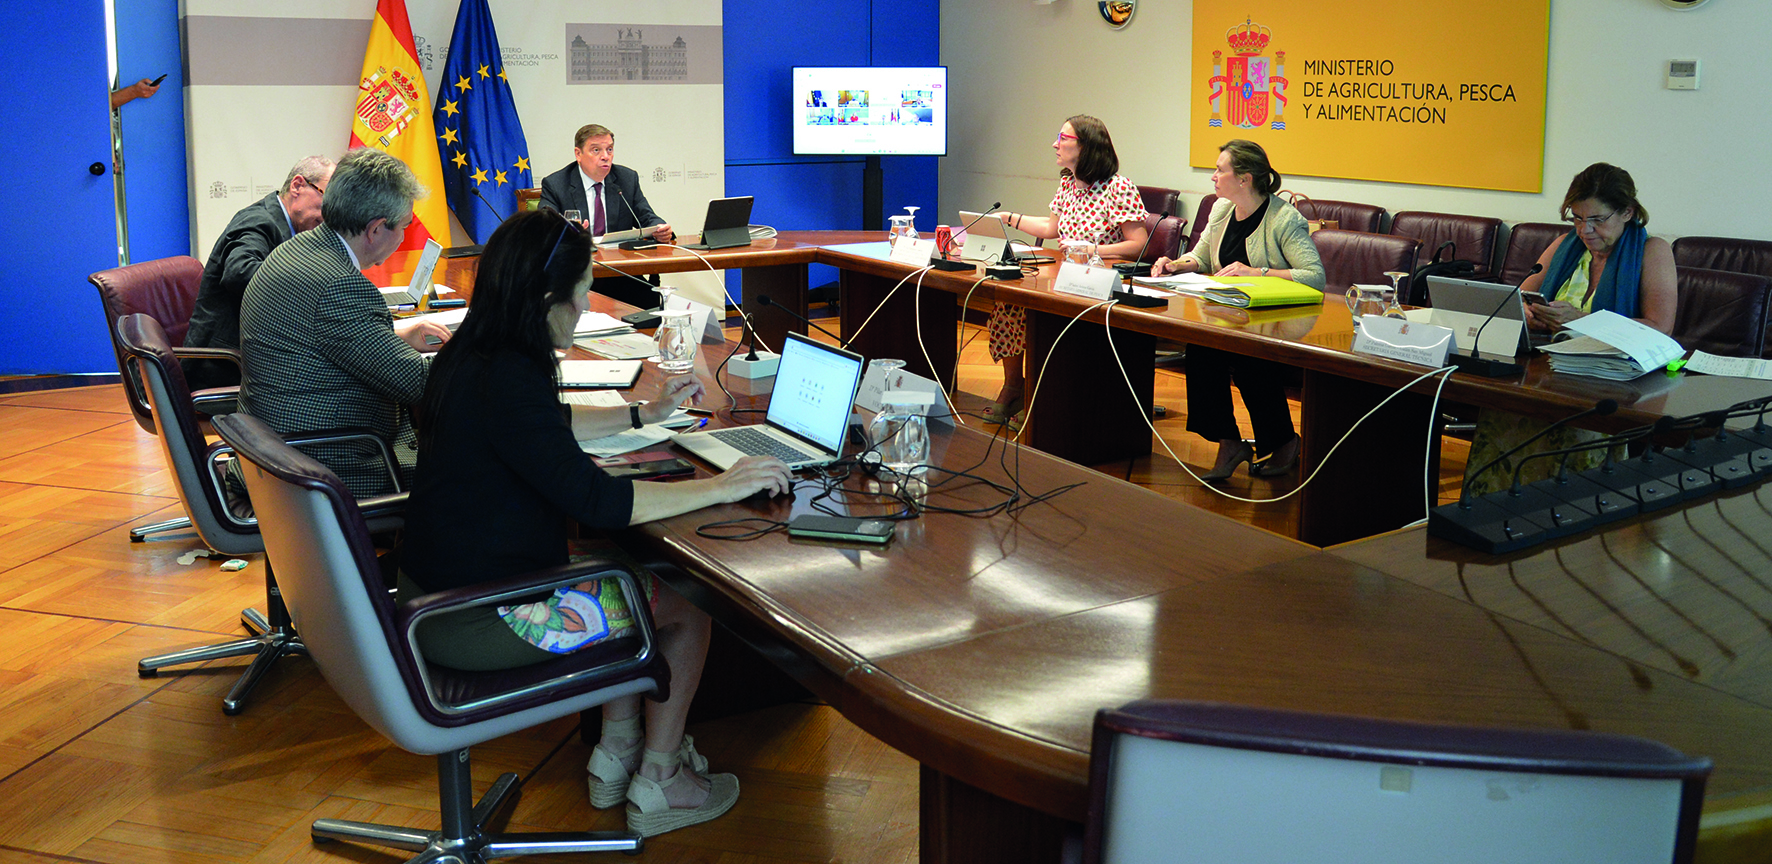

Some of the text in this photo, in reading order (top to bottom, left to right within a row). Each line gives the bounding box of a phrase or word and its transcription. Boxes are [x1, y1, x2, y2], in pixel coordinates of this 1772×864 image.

[503, 59, 539, 67] MENTACIÓN
[1304, 59, 1395, 76] MINISTERIO
[1303, 81, 1517, 103] DE AGRICULTURA, PESCA
[1302, 102, 1447, 124] Y ALIMENTACIÓN
